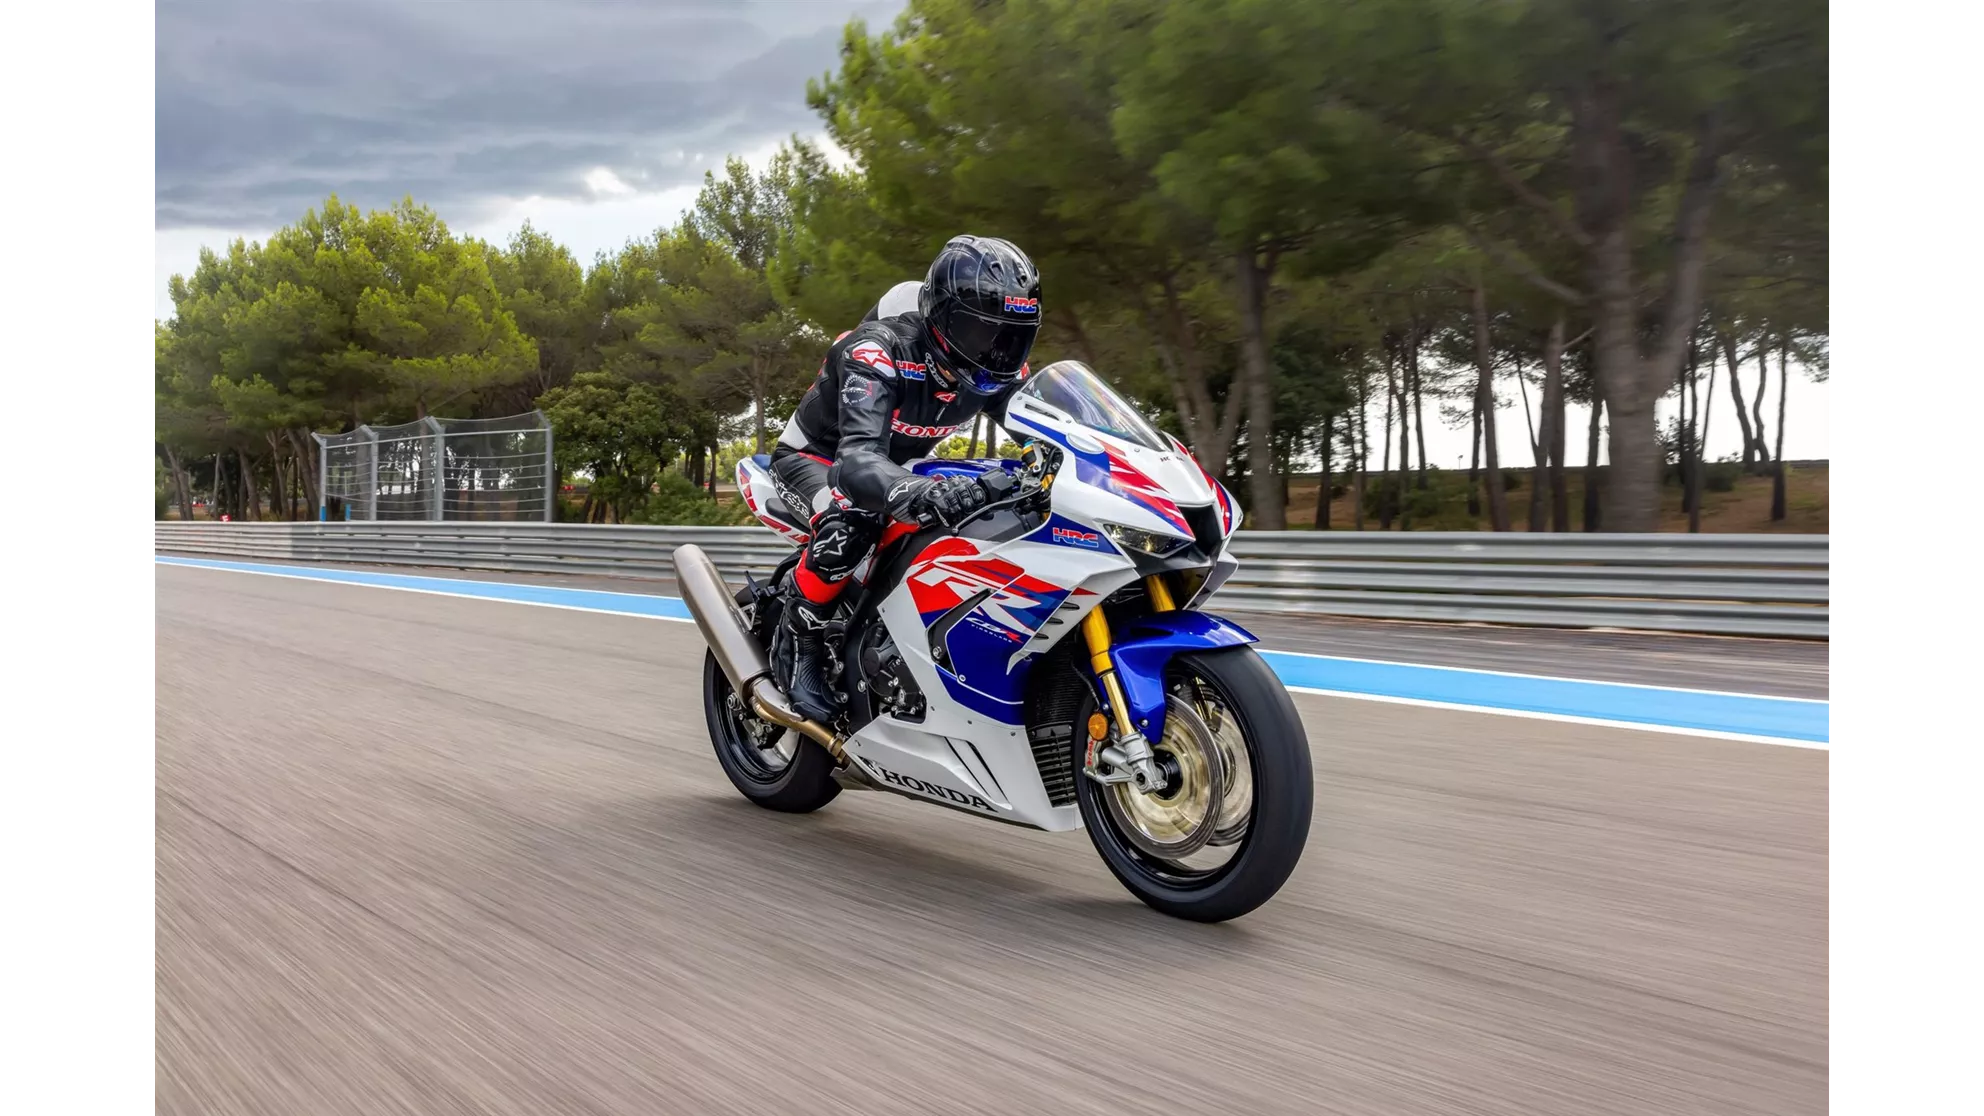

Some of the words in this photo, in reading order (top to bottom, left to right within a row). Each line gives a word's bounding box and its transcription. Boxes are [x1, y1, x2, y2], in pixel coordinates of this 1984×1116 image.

[1004, 296, 1037, 313] HRC
[896, 360, 926, 381] HRC
[1053, 527, 1099, 548] HRC
[879, 767, 999, 813] HONDA
